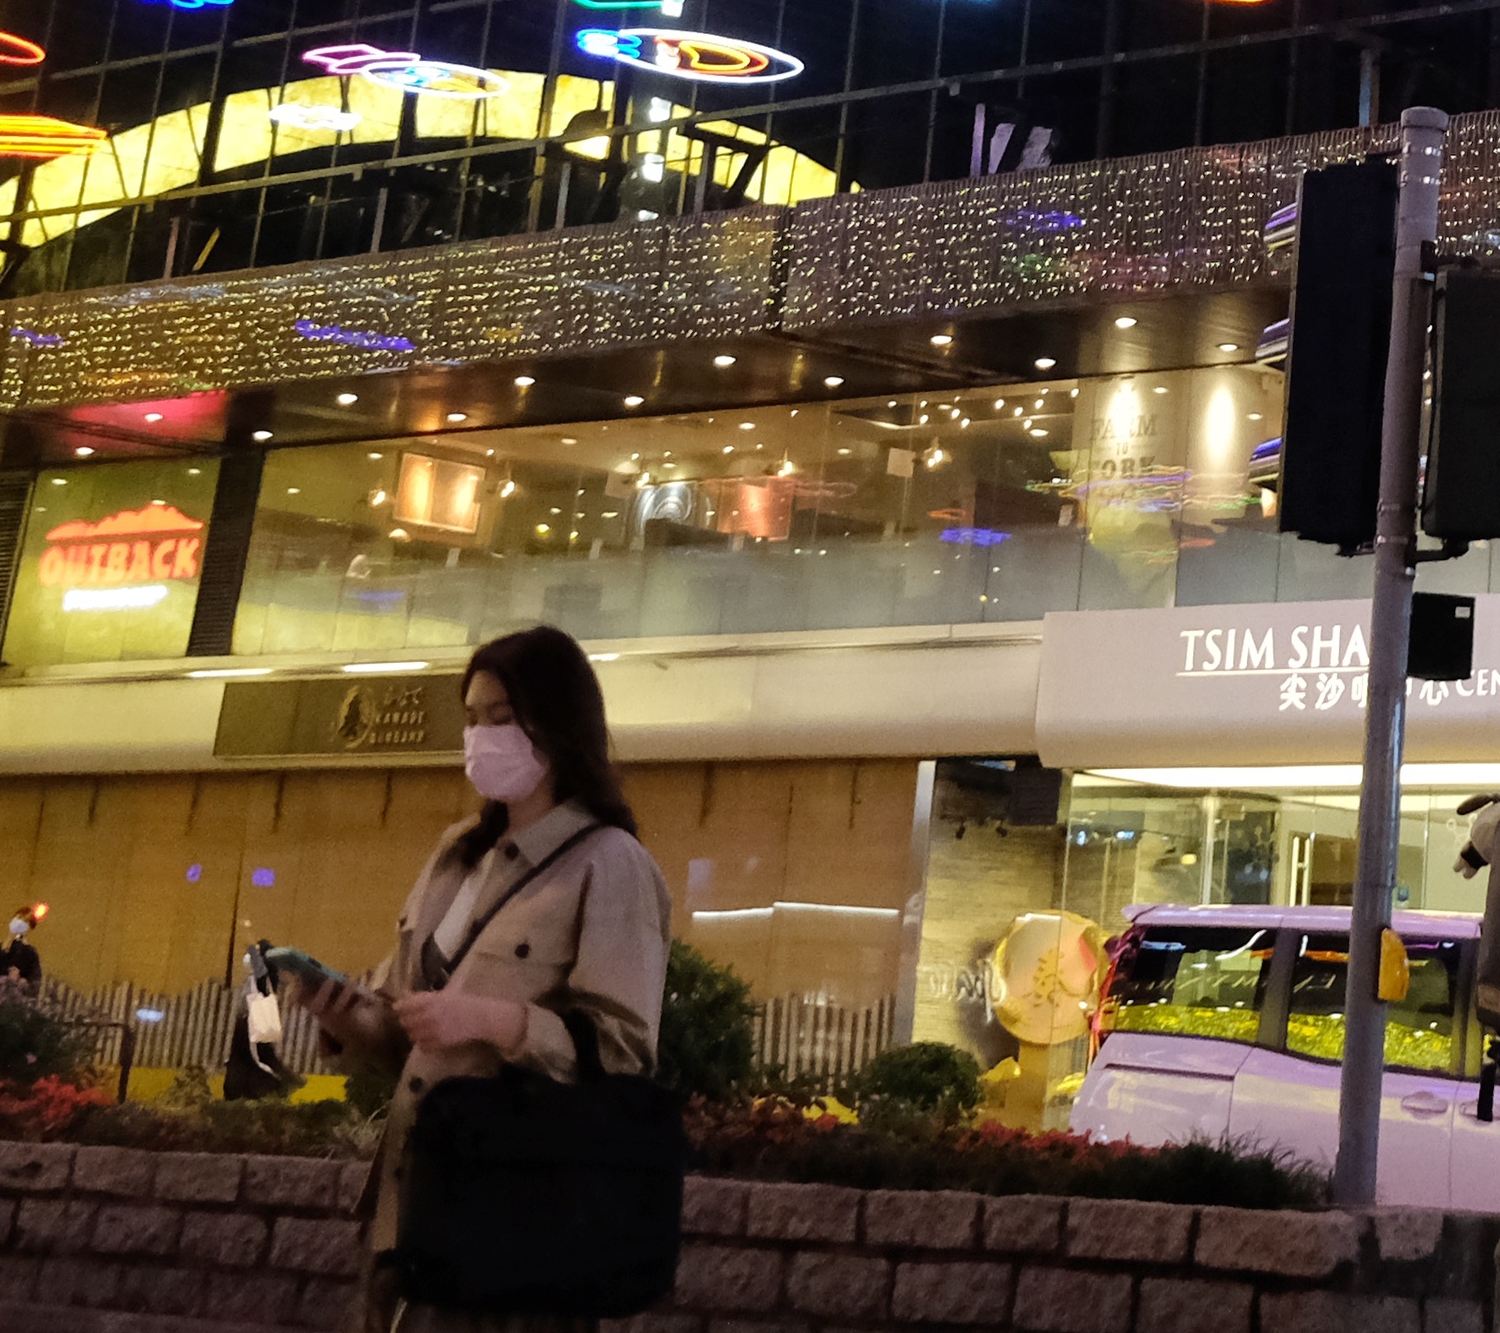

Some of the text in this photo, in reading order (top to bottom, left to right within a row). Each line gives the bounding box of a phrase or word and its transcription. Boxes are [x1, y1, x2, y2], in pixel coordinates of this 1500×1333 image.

[38, 537, 200, 587] OUTBACK
[1180, 623, 1370, 672] TSIM SHA
